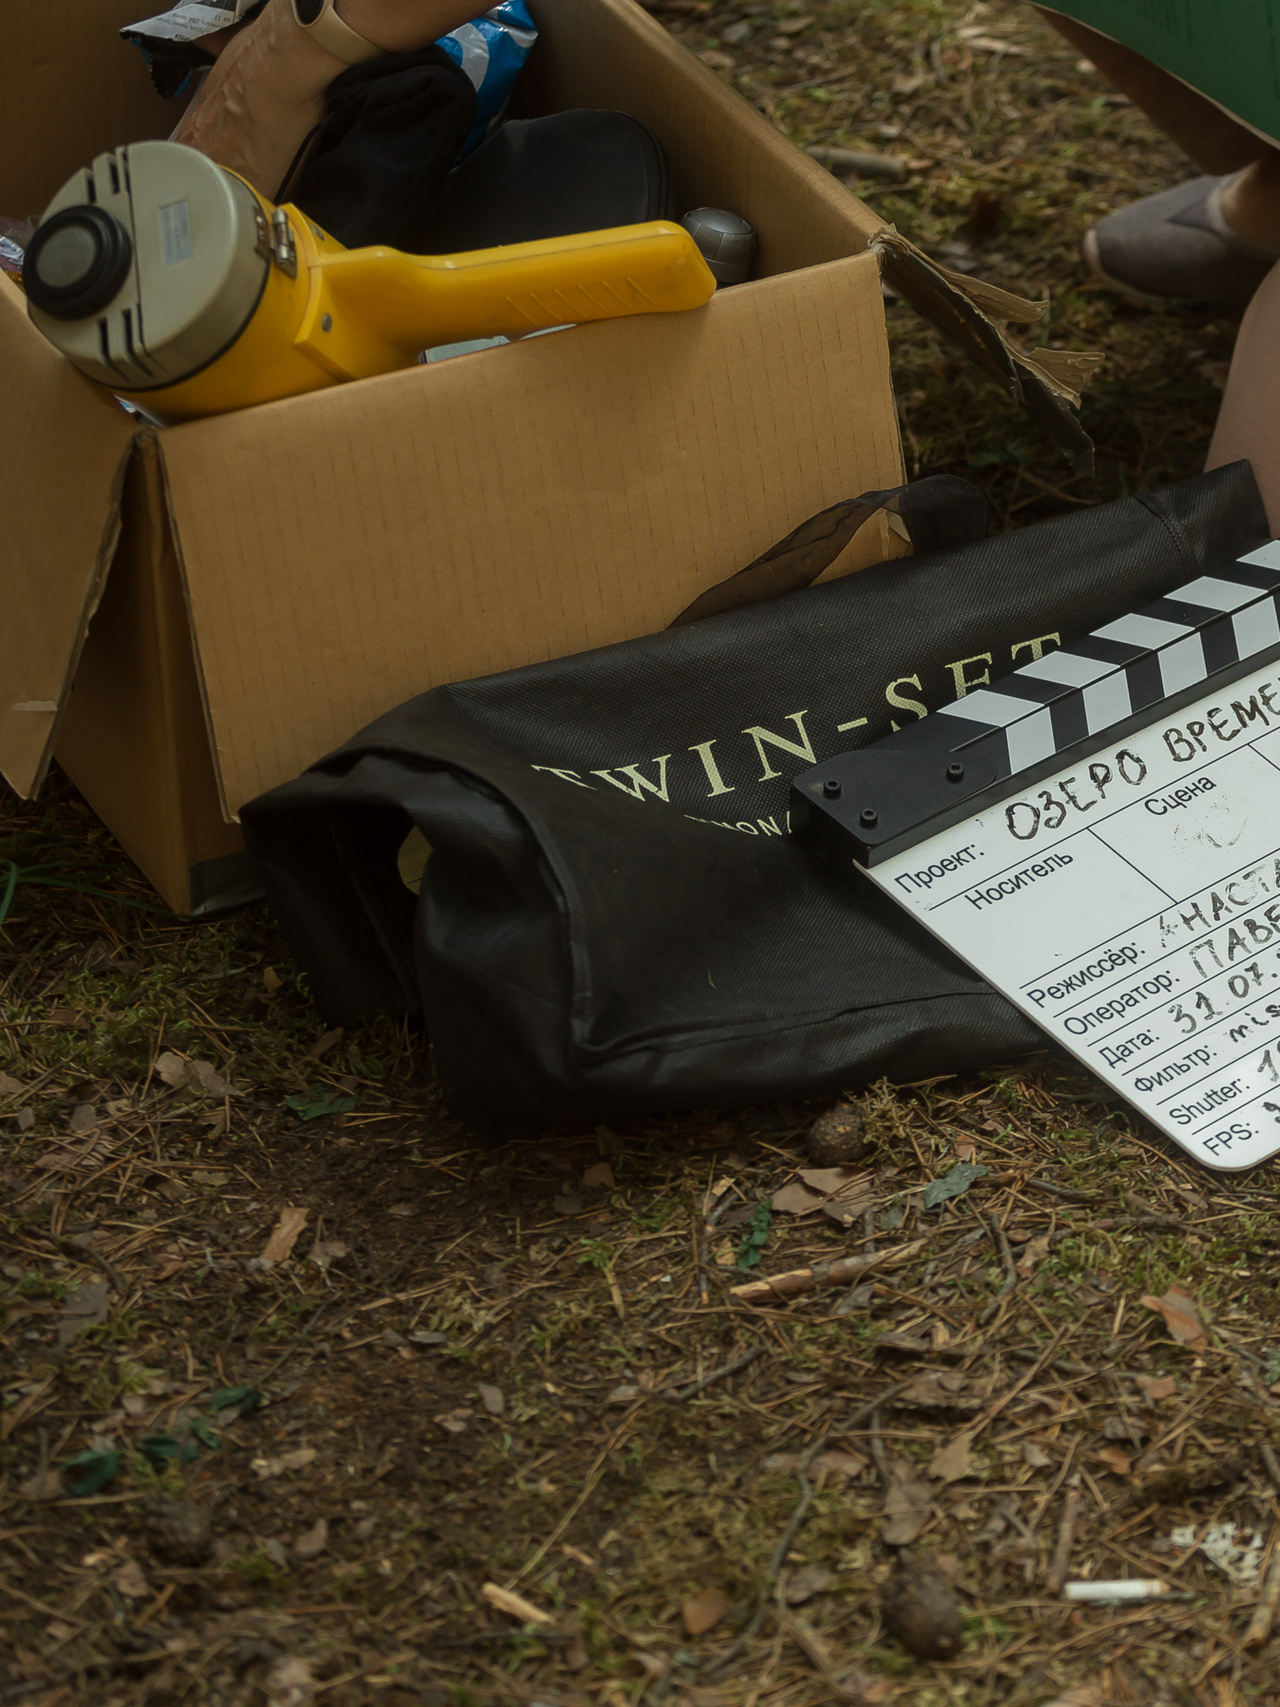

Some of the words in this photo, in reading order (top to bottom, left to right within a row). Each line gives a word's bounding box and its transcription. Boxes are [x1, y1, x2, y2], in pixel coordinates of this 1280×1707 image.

[1005, 748, 1147, 840] ОЗЕРО
[1145, 776, 1217, 816] Сцена
[894, 843, 985, 893] Проект:
[964, 854, 1074, 910] Носитель
[1026, 942, 1146, 1009] Режиссёр:
[1064, 970, 1180, 1035] Оператор:
[1099, 1029, 1160, 1069] Дата:
[1134, 1044, 1217, 1092] Фильтр:
[1169, 1078, 1251, 1125] Shutter:
[1203, 1122, 1260, 1157] FPS:
